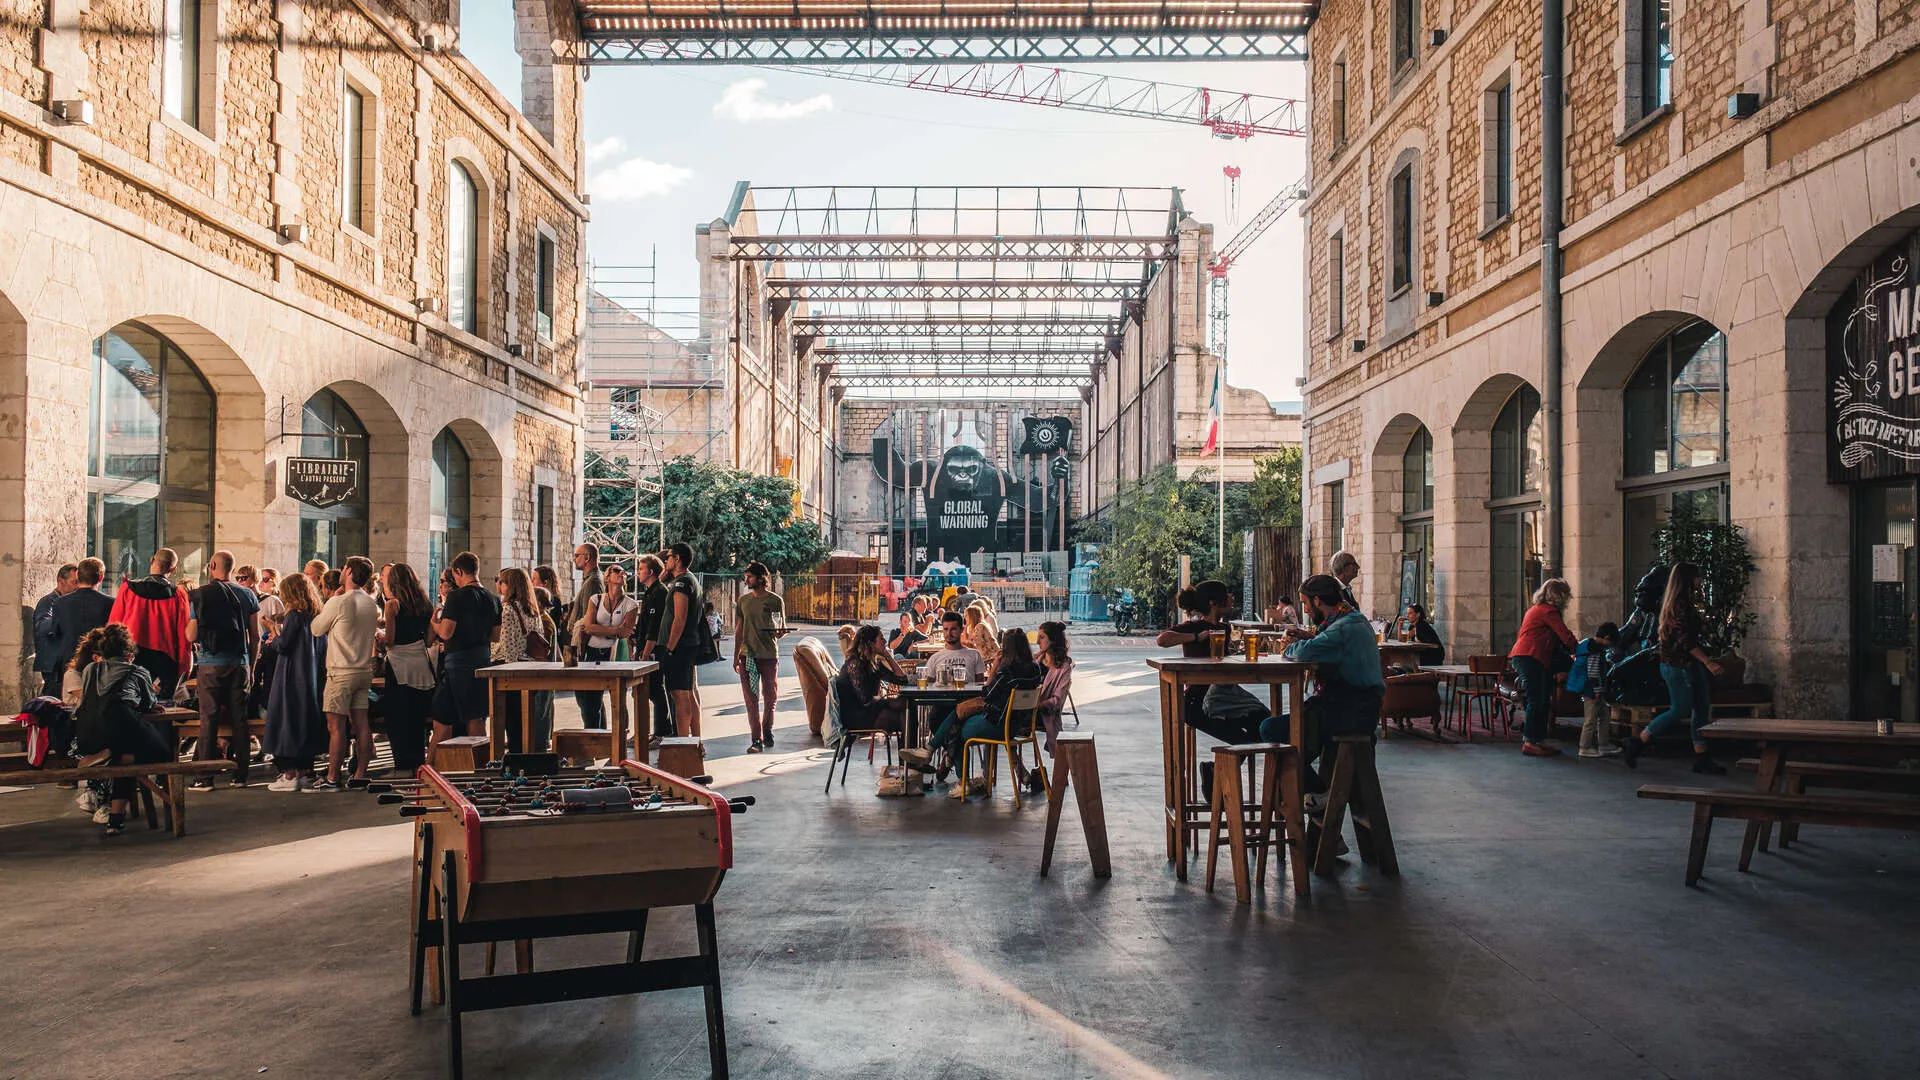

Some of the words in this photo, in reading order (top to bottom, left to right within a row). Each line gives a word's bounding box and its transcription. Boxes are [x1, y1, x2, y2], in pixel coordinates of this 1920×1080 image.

[1888, 346, 1920, 400] GE
[296, 462, 348, 476] LIBRAIRIE
[944, 500, 984, 514] GLOBAL
[940, 515, 989, 529] WARNING
